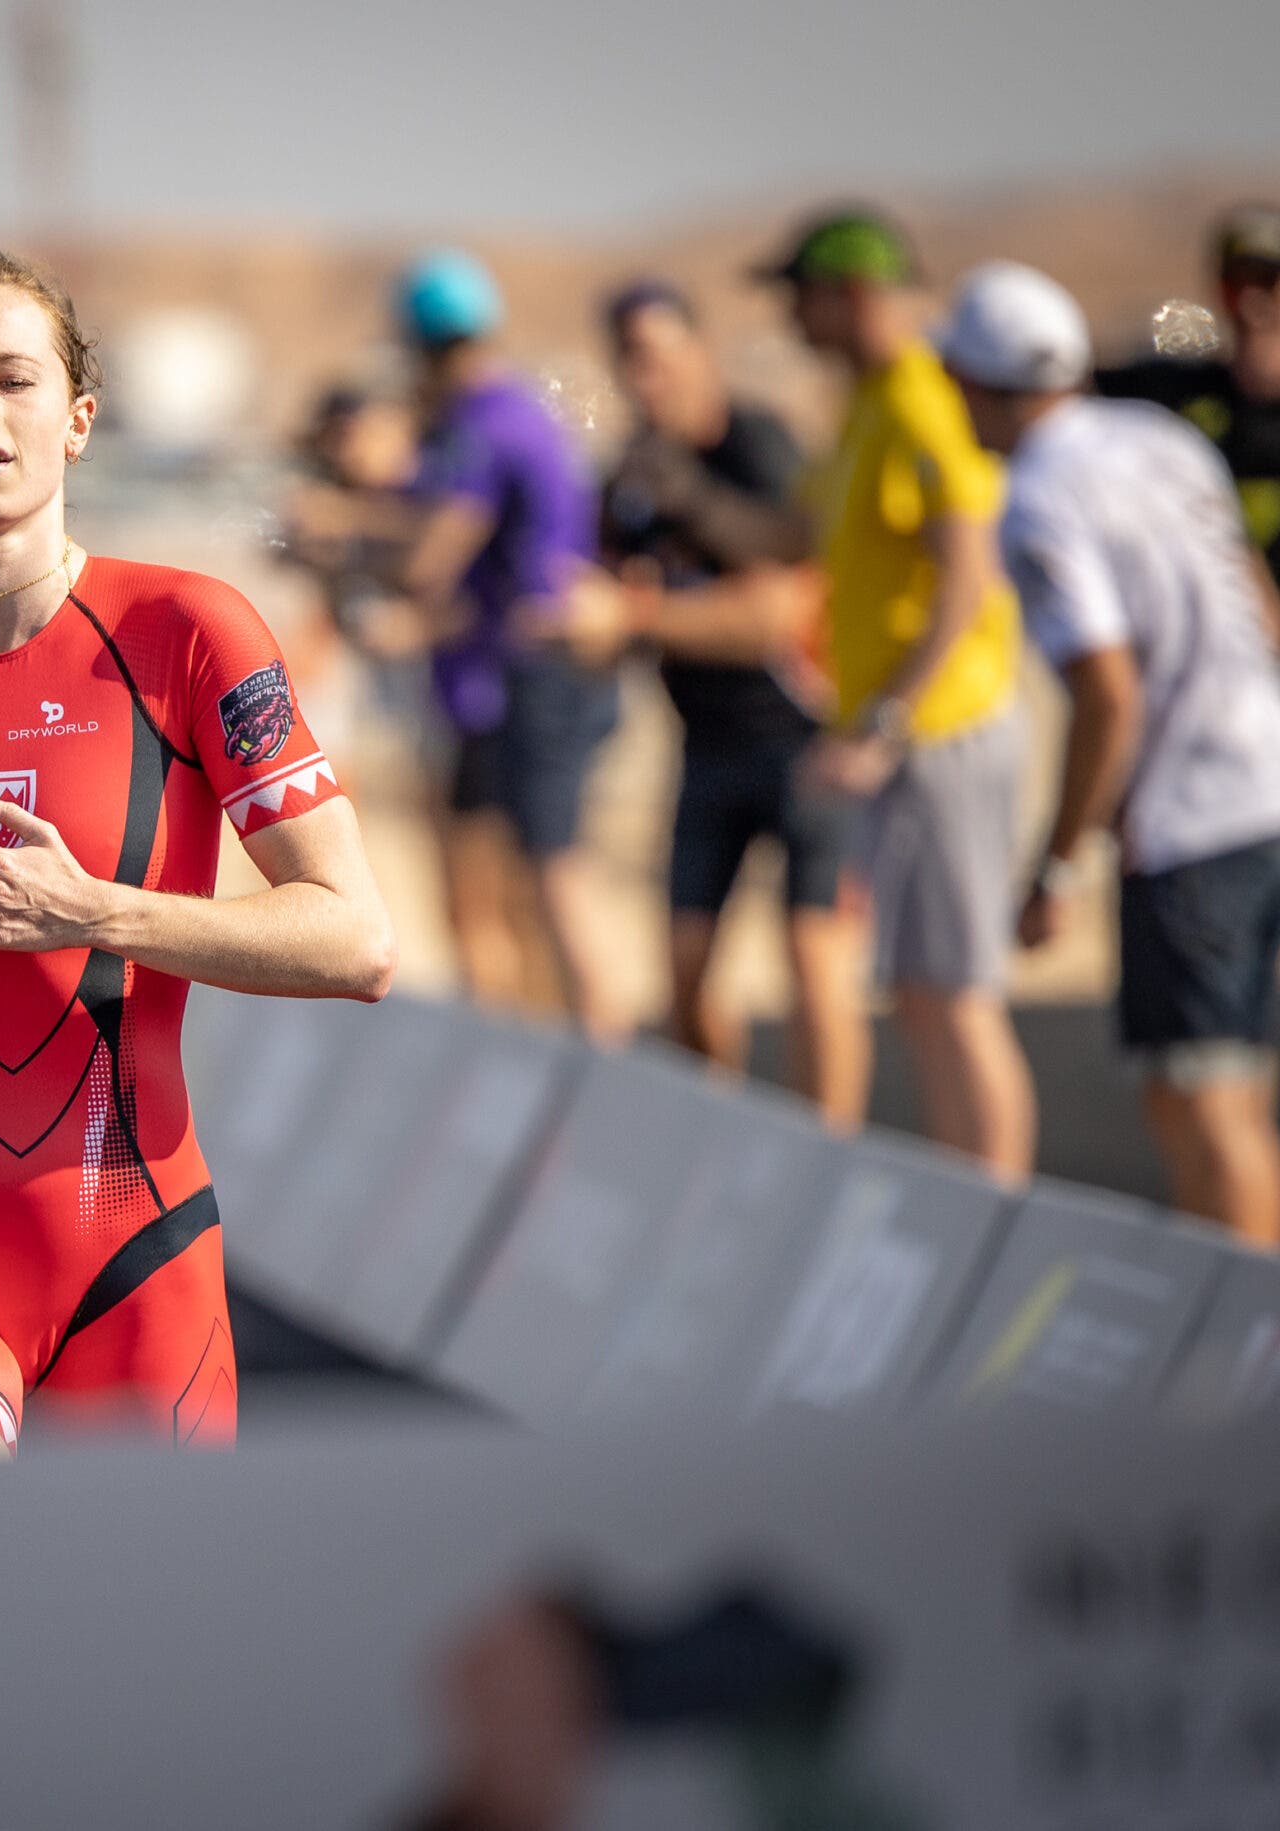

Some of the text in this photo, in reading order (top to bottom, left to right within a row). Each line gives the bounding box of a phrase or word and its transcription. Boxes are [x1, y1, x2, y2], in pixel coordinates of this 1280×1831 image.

[236, 670, 277, 696] BAHRAIN
[223, 684, 290, 722] SCORPIONS
[7, 721, 99, 741] DRYWORLD
